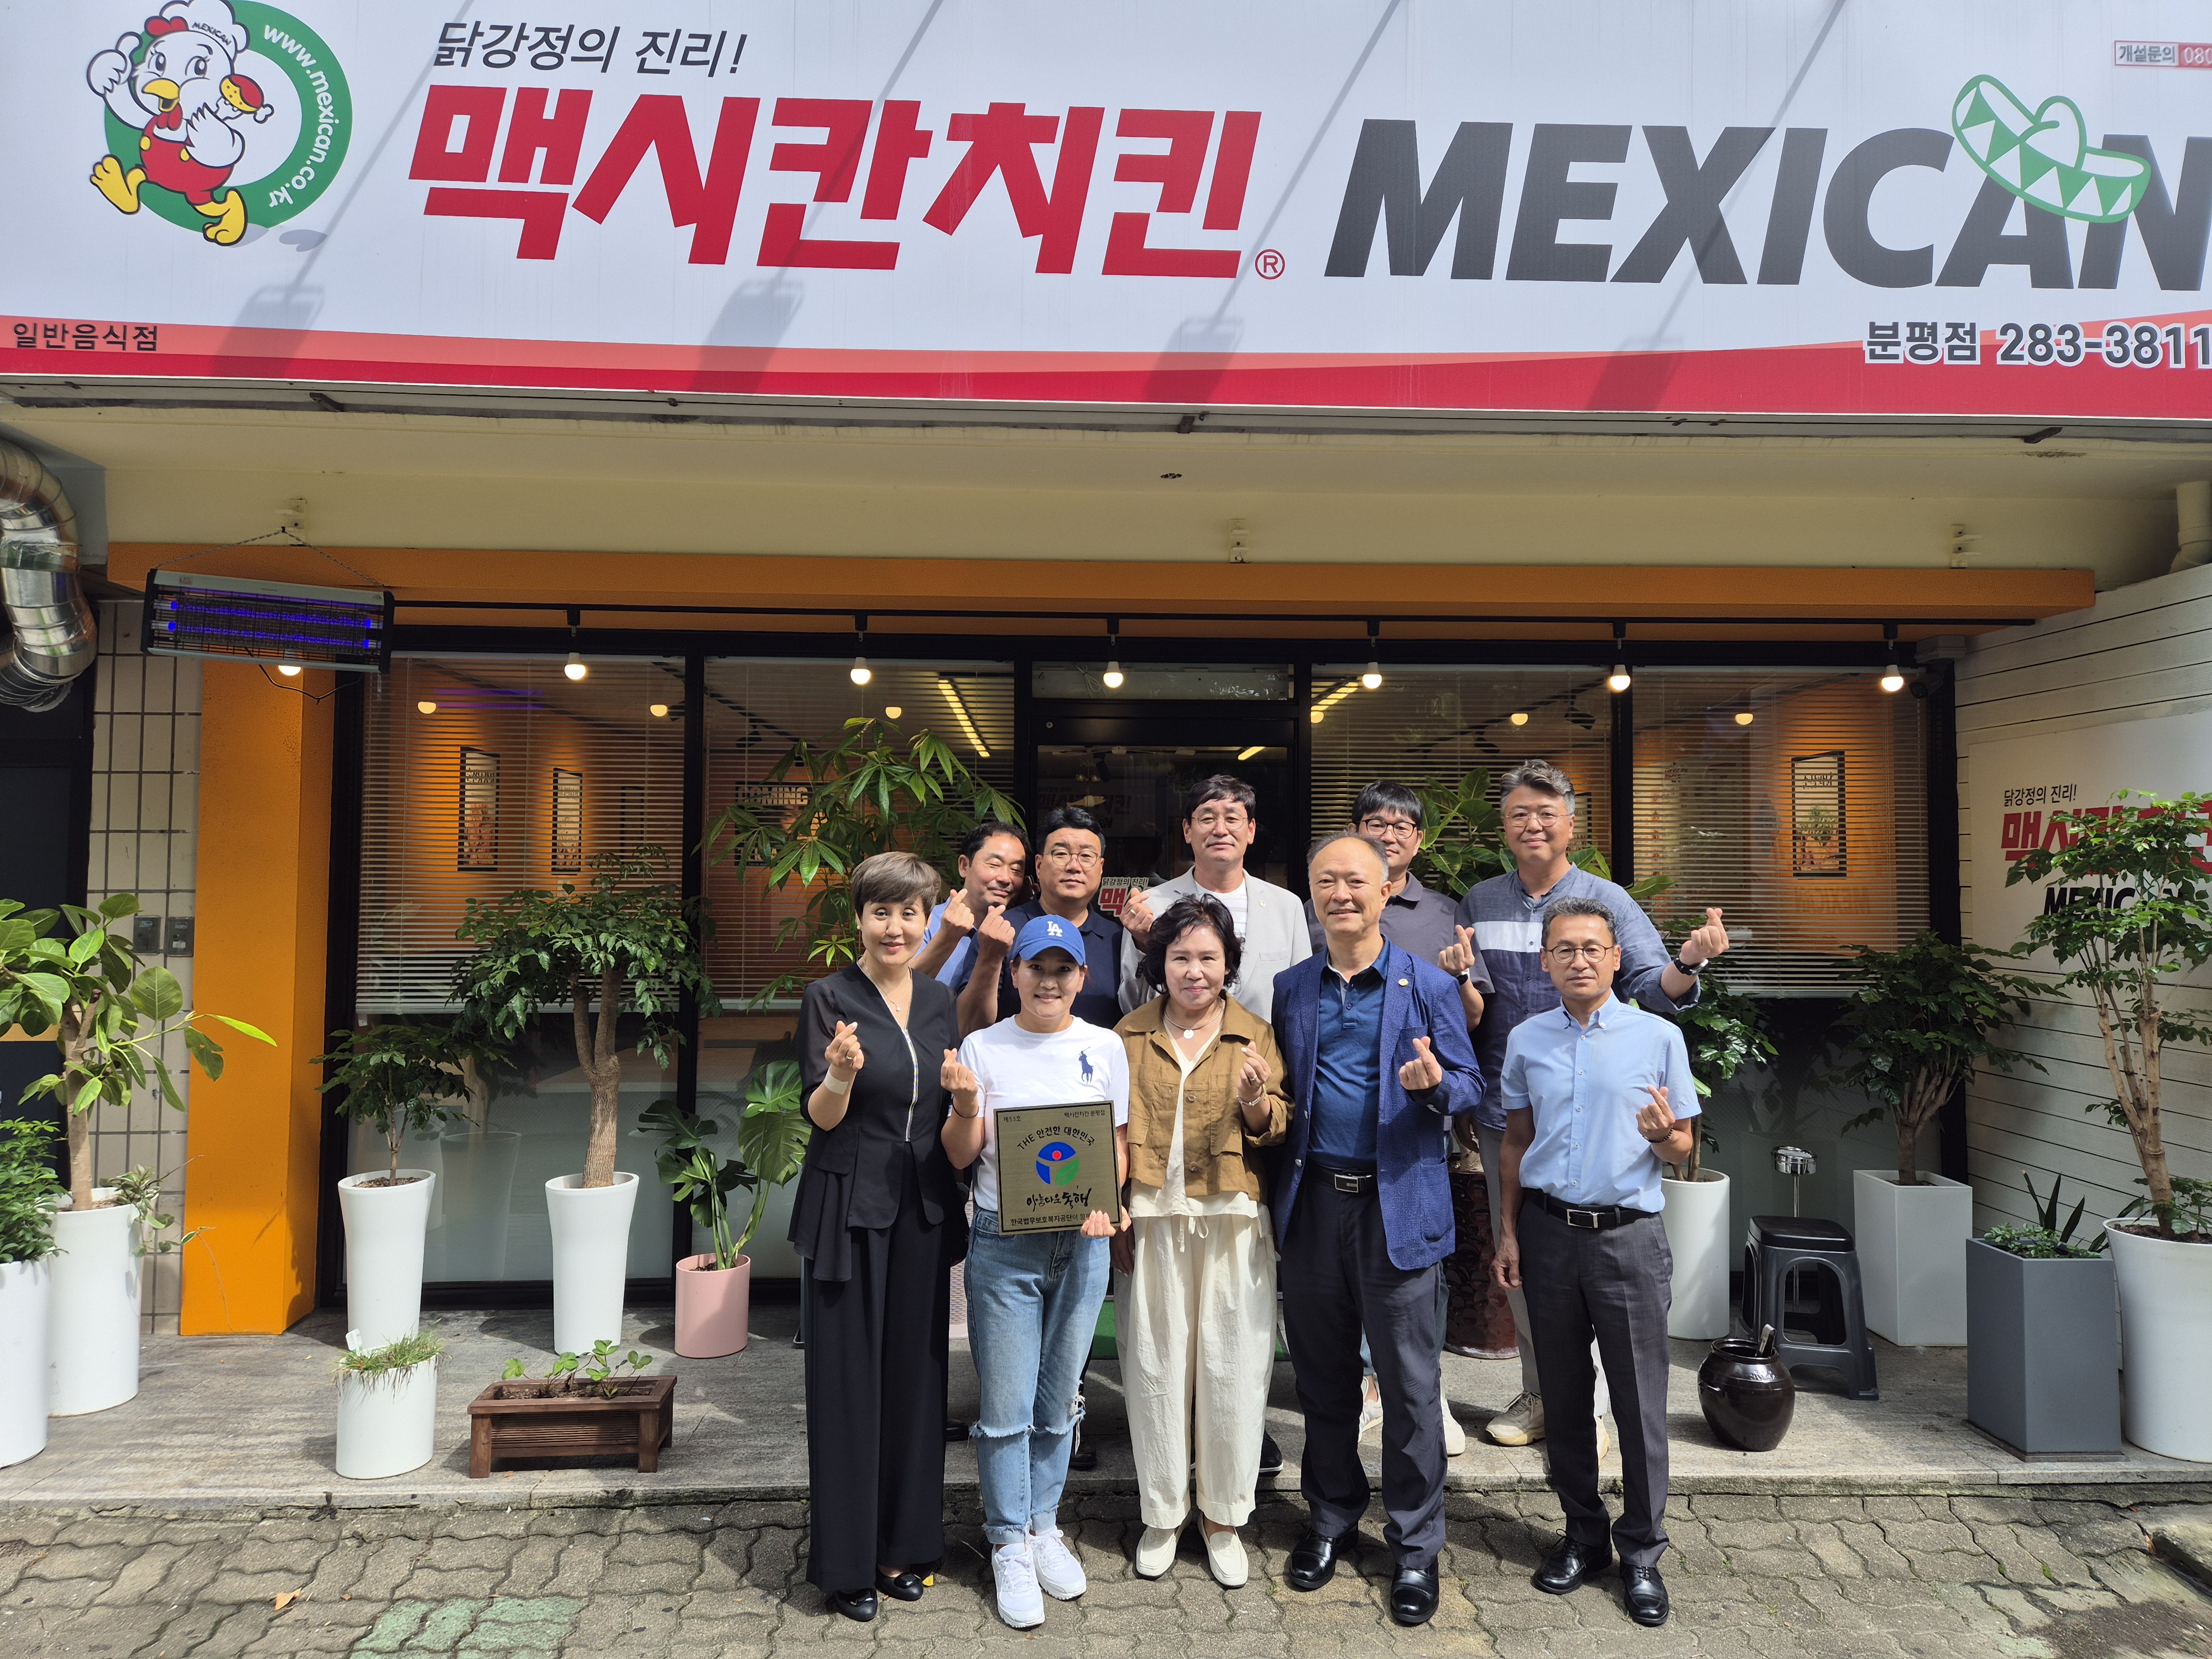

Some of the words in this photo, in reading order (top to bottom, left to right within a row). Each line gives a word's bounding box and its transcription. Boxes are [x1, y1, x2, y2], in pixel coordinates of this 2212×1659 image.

[191, 22, 232, 46] MEXICAN
[434, 20, 620, 74] 닭강정의
[635, 29, 748, 77] 진리!
[2119, 45, 2176, 64] 개설문의
[264, 24, 340, 207] www.mexican.co.kr
[408, 85, 1262, 279] 맥시칸치킨
[1324, 119, 2212, 291] MEXICAN
[13, 322, 159, 352] 일반음식점
[1867, 322, 1977, 361] 분평점
[1999, 322, 2212, 366] 283-3811
[2004, 786, 2047, 807] 닭강정의
[2051, 784, 2077, 804] 진리!
[1047, 921, 1063, 937] LA
[1017, 1133, 1036, 1150] THE
[1036, 1125, 1061, 1139] 안전한
[1064, 1126, 1095, 1147] 대한민국
